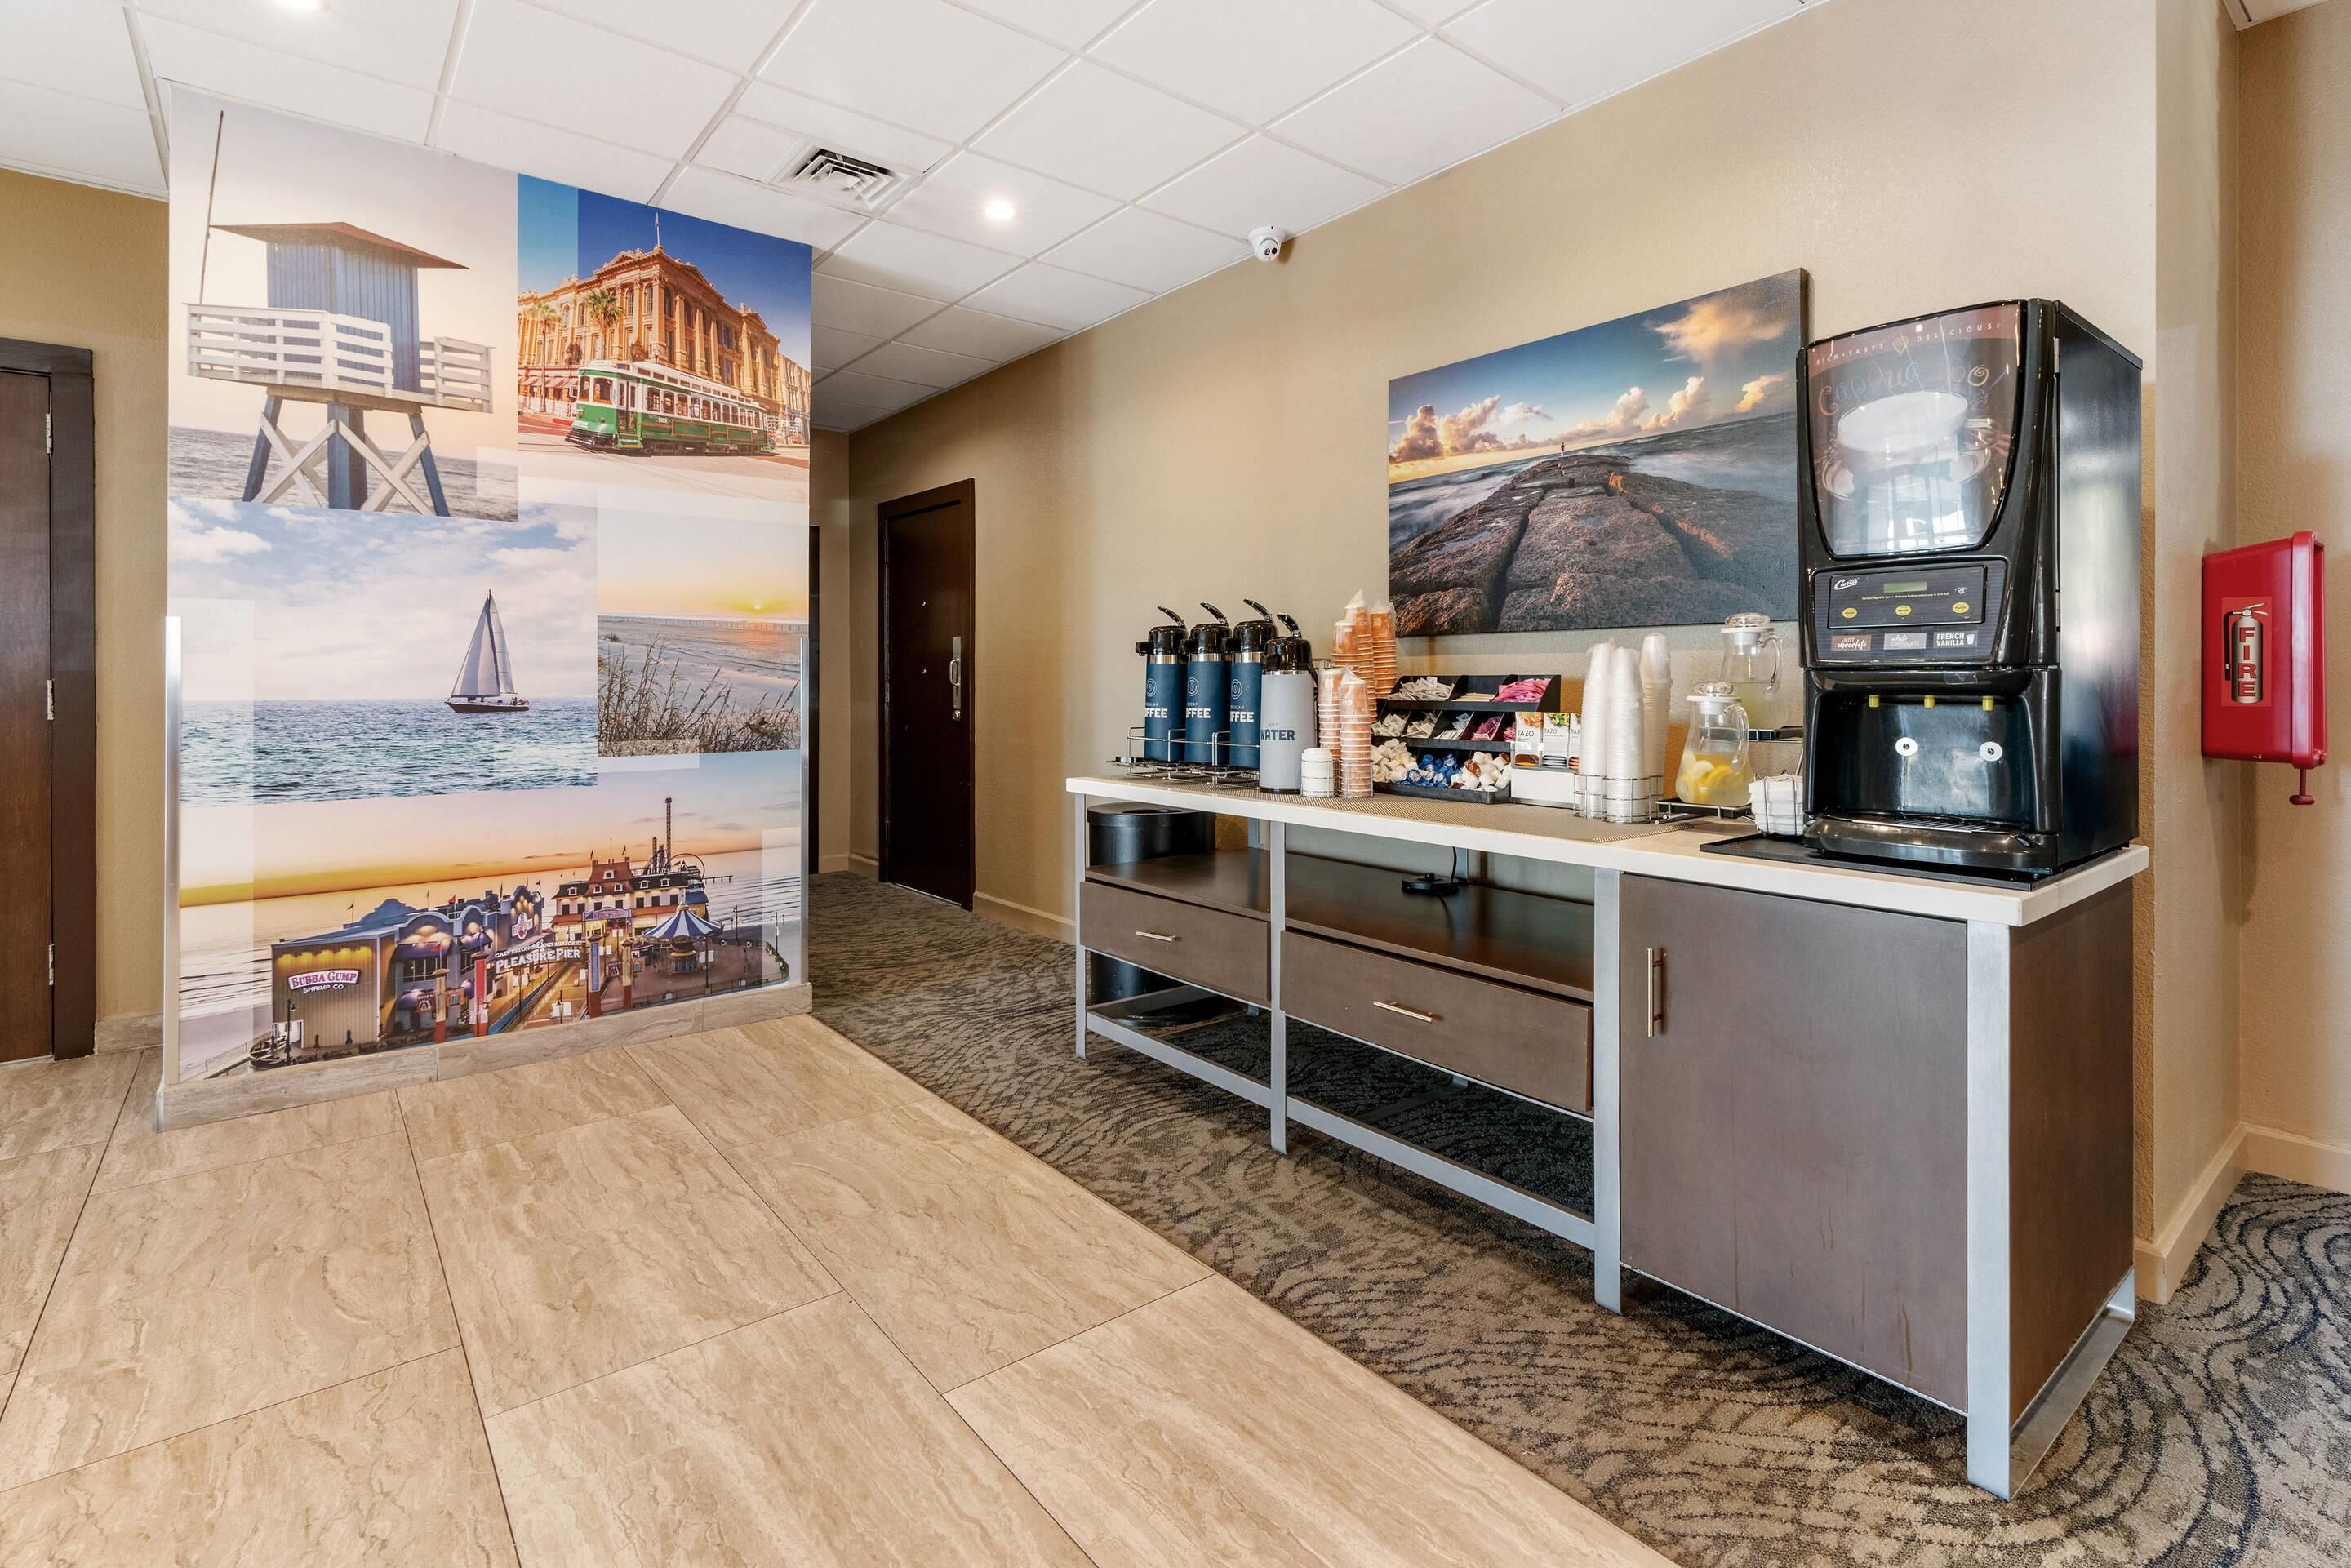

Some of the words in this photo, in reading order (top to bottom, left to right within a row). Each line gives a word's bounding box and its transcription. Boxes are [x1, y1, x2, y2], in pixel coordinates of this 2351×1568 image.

[1816, 353, 1838, 366] RICH
[1848, 342, 1885, 357] TASTY
[1837, 639, 1867, 650] chocolate
[2237, 626, 2257, 698] FIRE
[1144, 708, 1168, 718] FFEE
[1230, 711, 1255, 722] FFEE
[496, 951, 556, 975] PLEASURE
[556, 948, 581, 961] PIER
[291, 974, 326, 988] BUBBA
[327, 971, 357, 982] GUMP
[303, 984, 331, 993] SHRIMP
